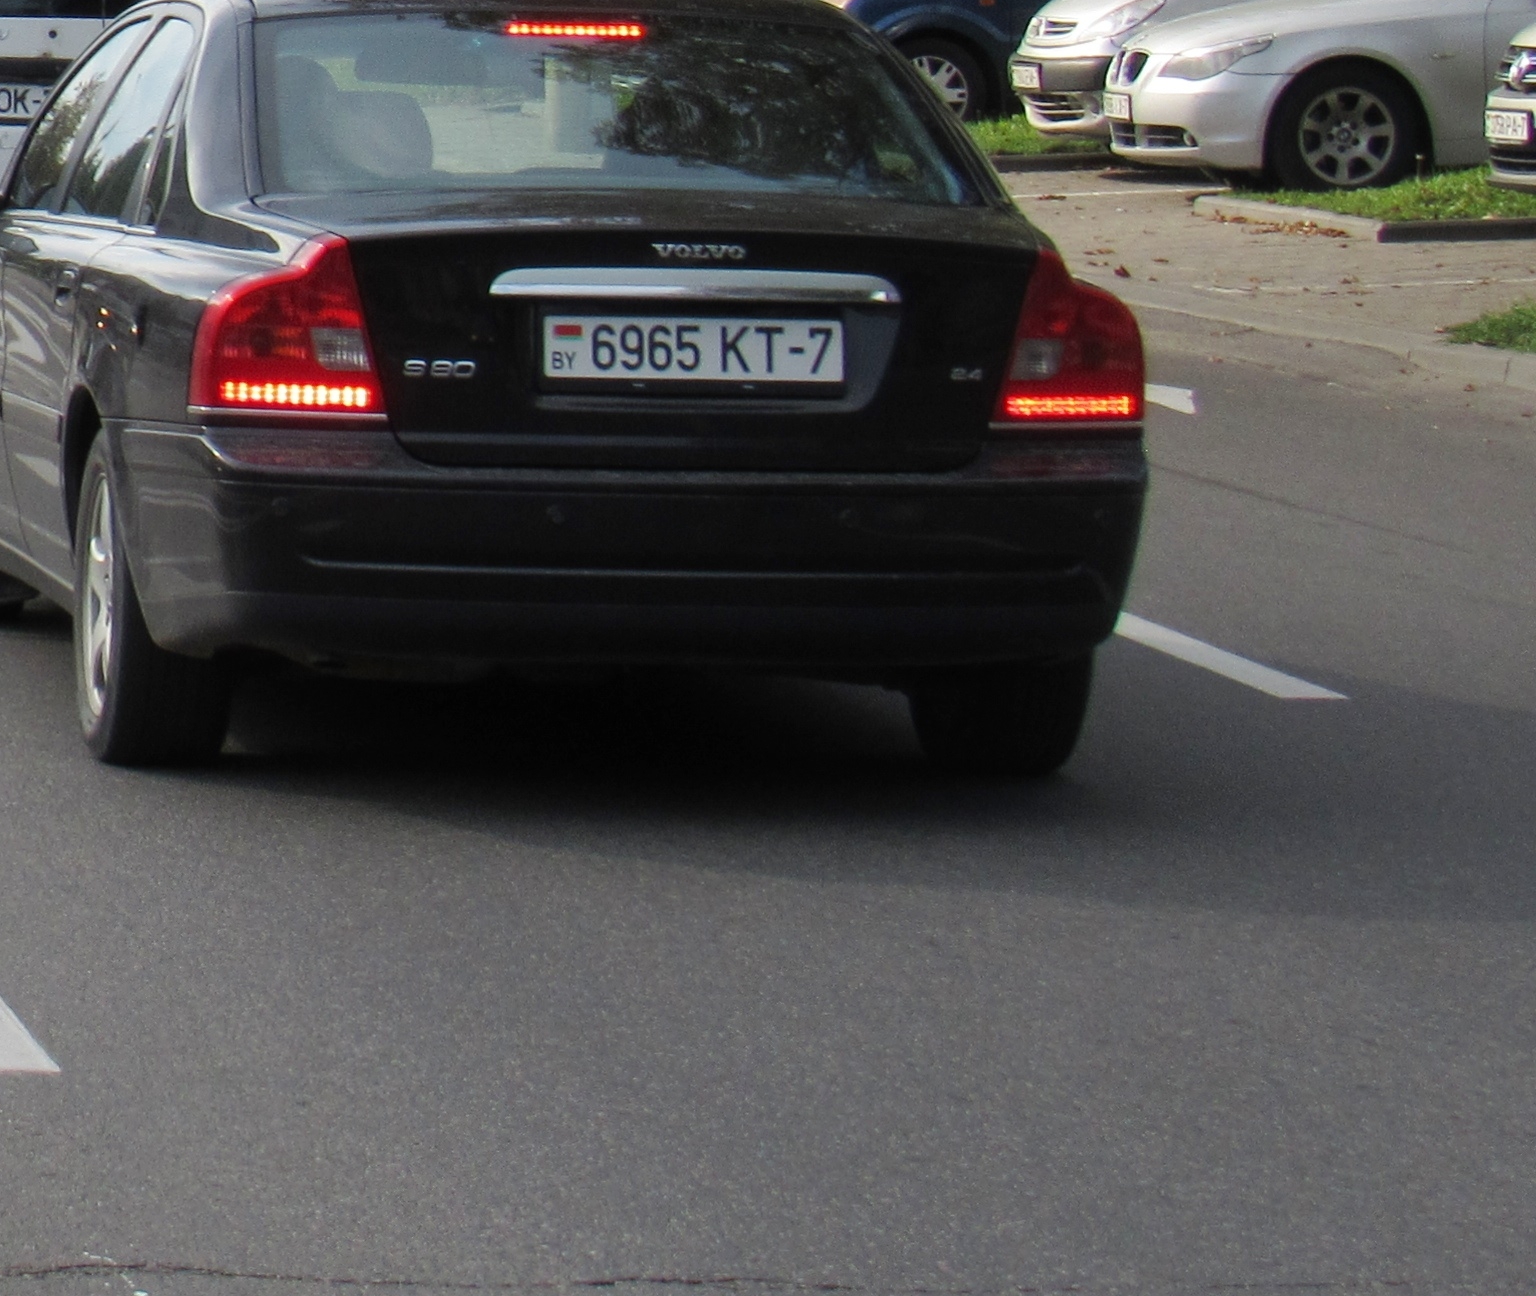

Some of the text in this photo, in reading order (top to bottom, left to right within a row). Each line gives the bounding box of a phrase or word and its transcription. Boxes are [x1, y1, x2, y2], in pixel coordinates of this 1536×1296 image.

[651, 242, 747, 259] VOLVO
[591, 324, 834, 375] 6965 KT-7
[551, 351, 577, 370] BY
